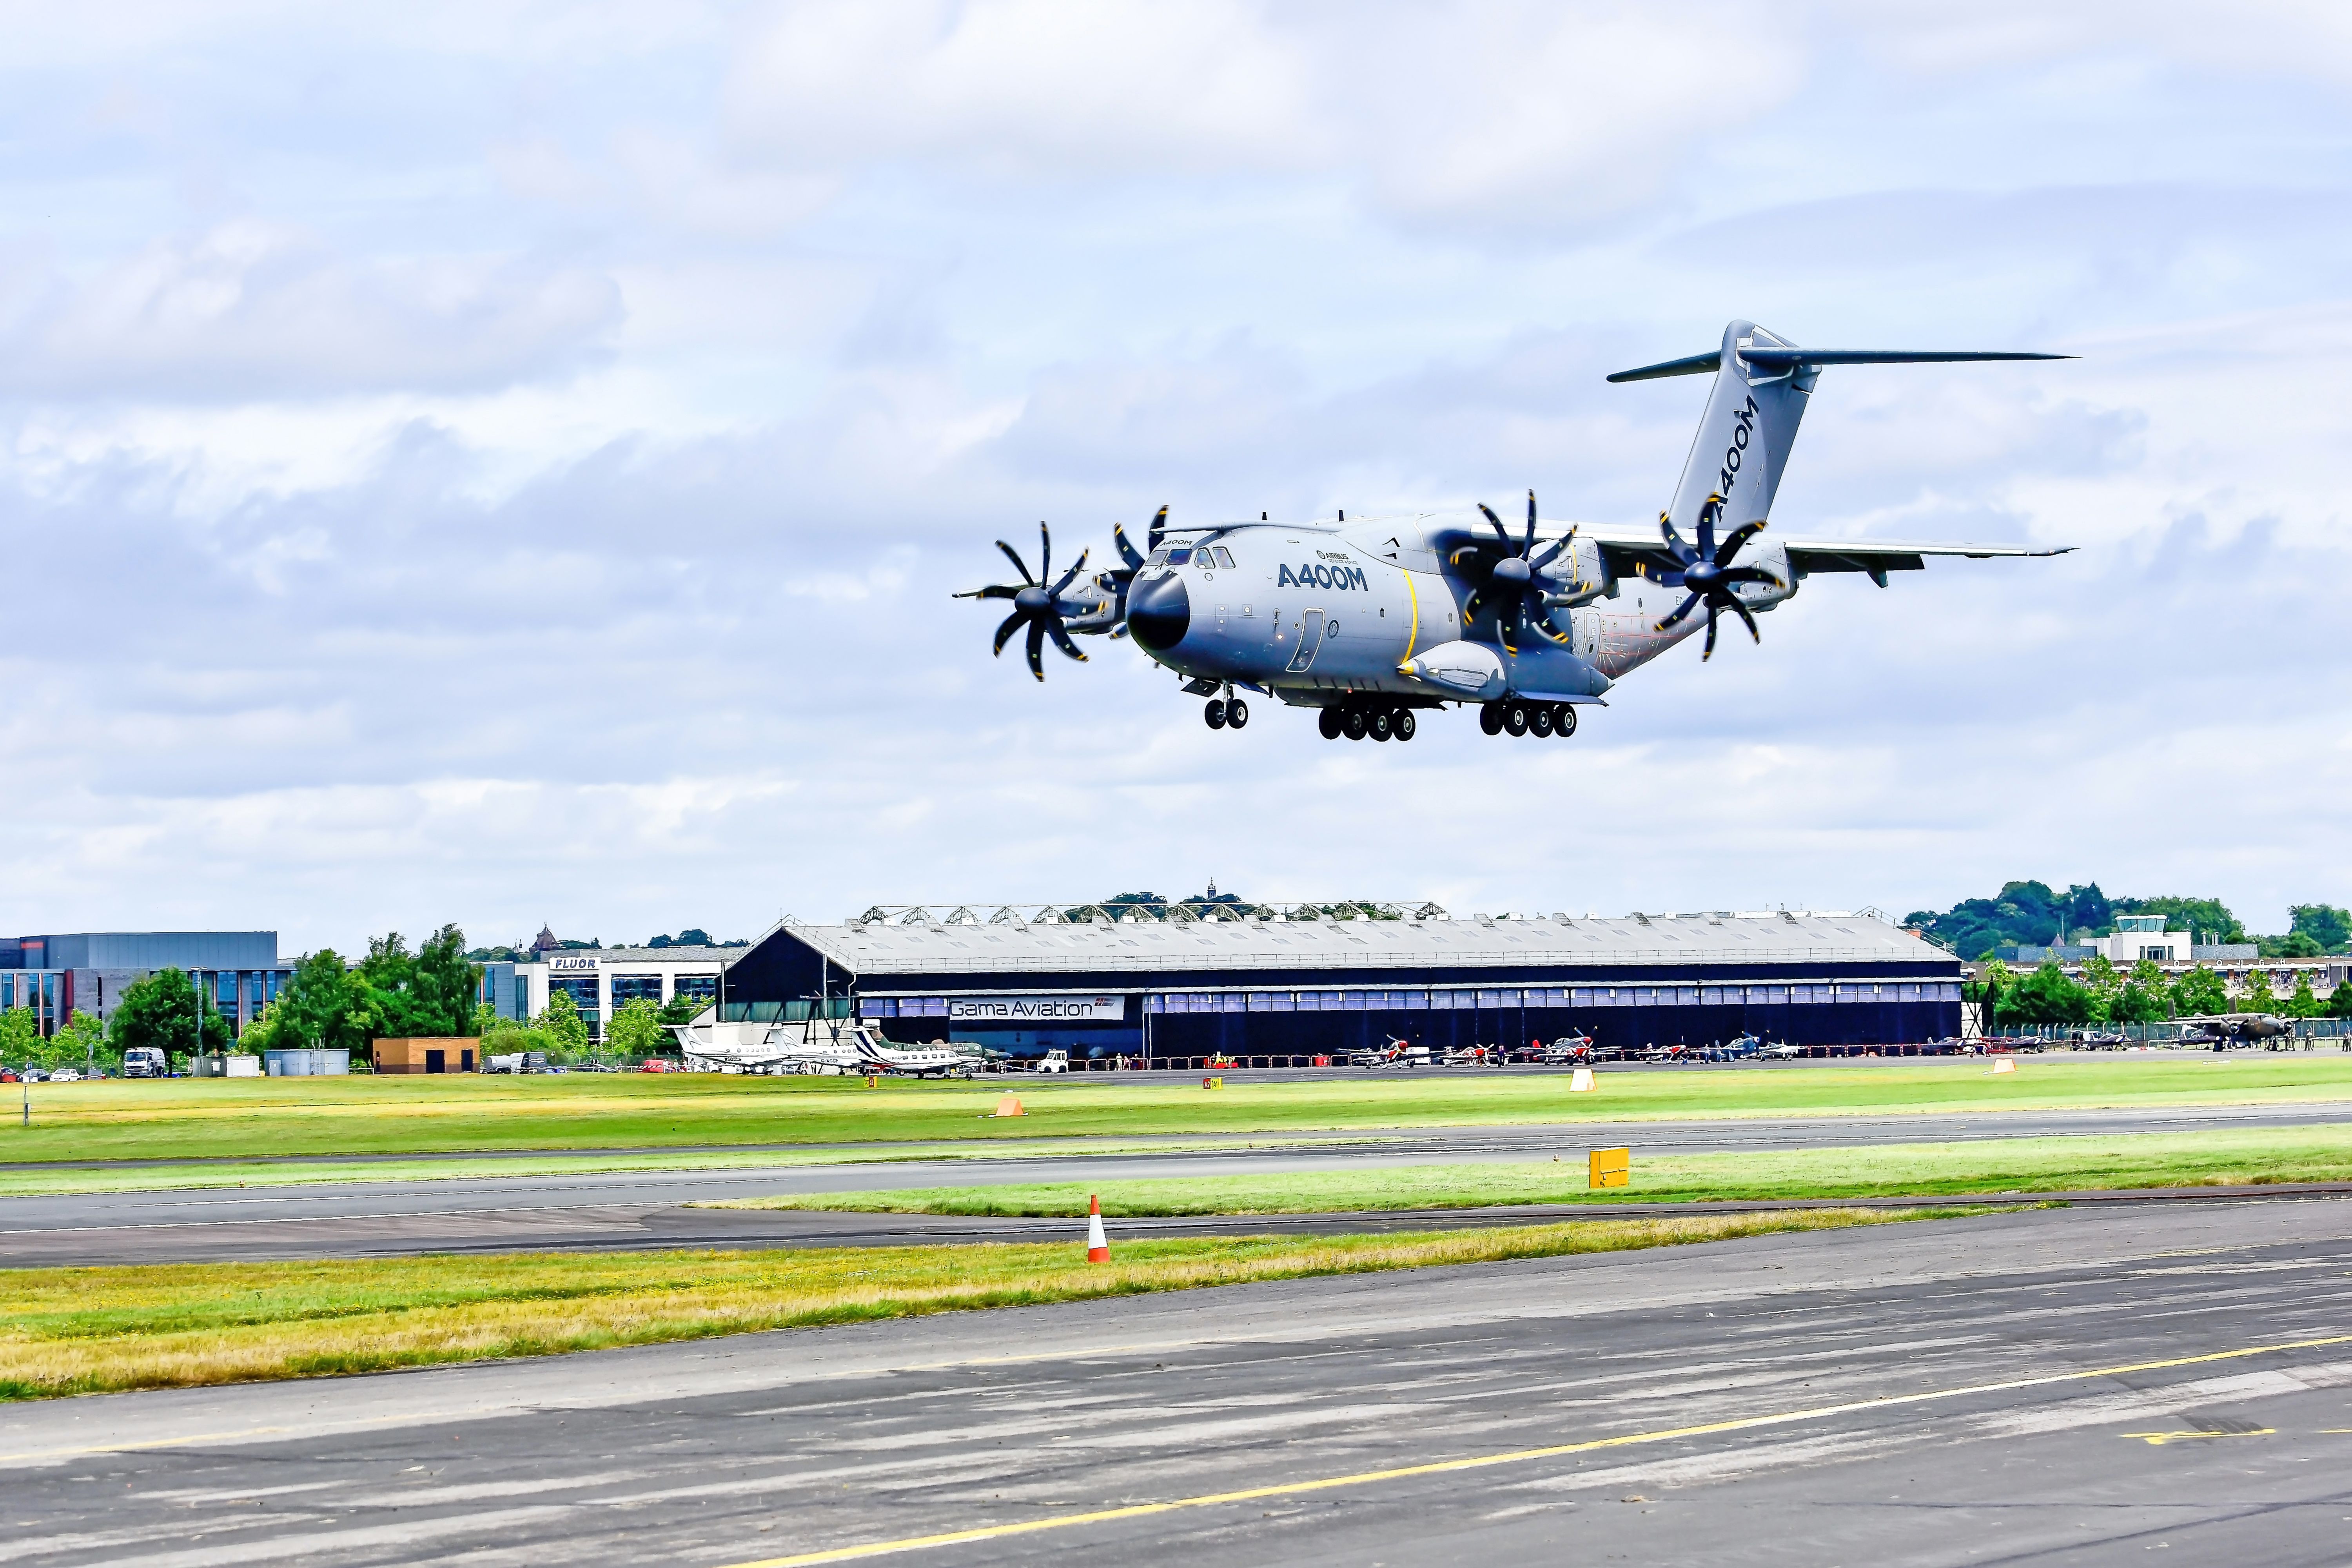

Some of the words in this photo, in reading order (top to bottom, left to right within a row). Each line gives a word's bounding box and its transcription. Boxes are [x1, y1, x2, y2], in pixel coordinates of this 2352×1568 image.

[1714, 394, 1760, 523] A400M
[1278, 563, 1368, 592] A400M
[555, 959, 595, 969] FLUOR
[950, 1001, 1008, 1016] Gama
[1011, 1000, 1093, 1016] Aviation
